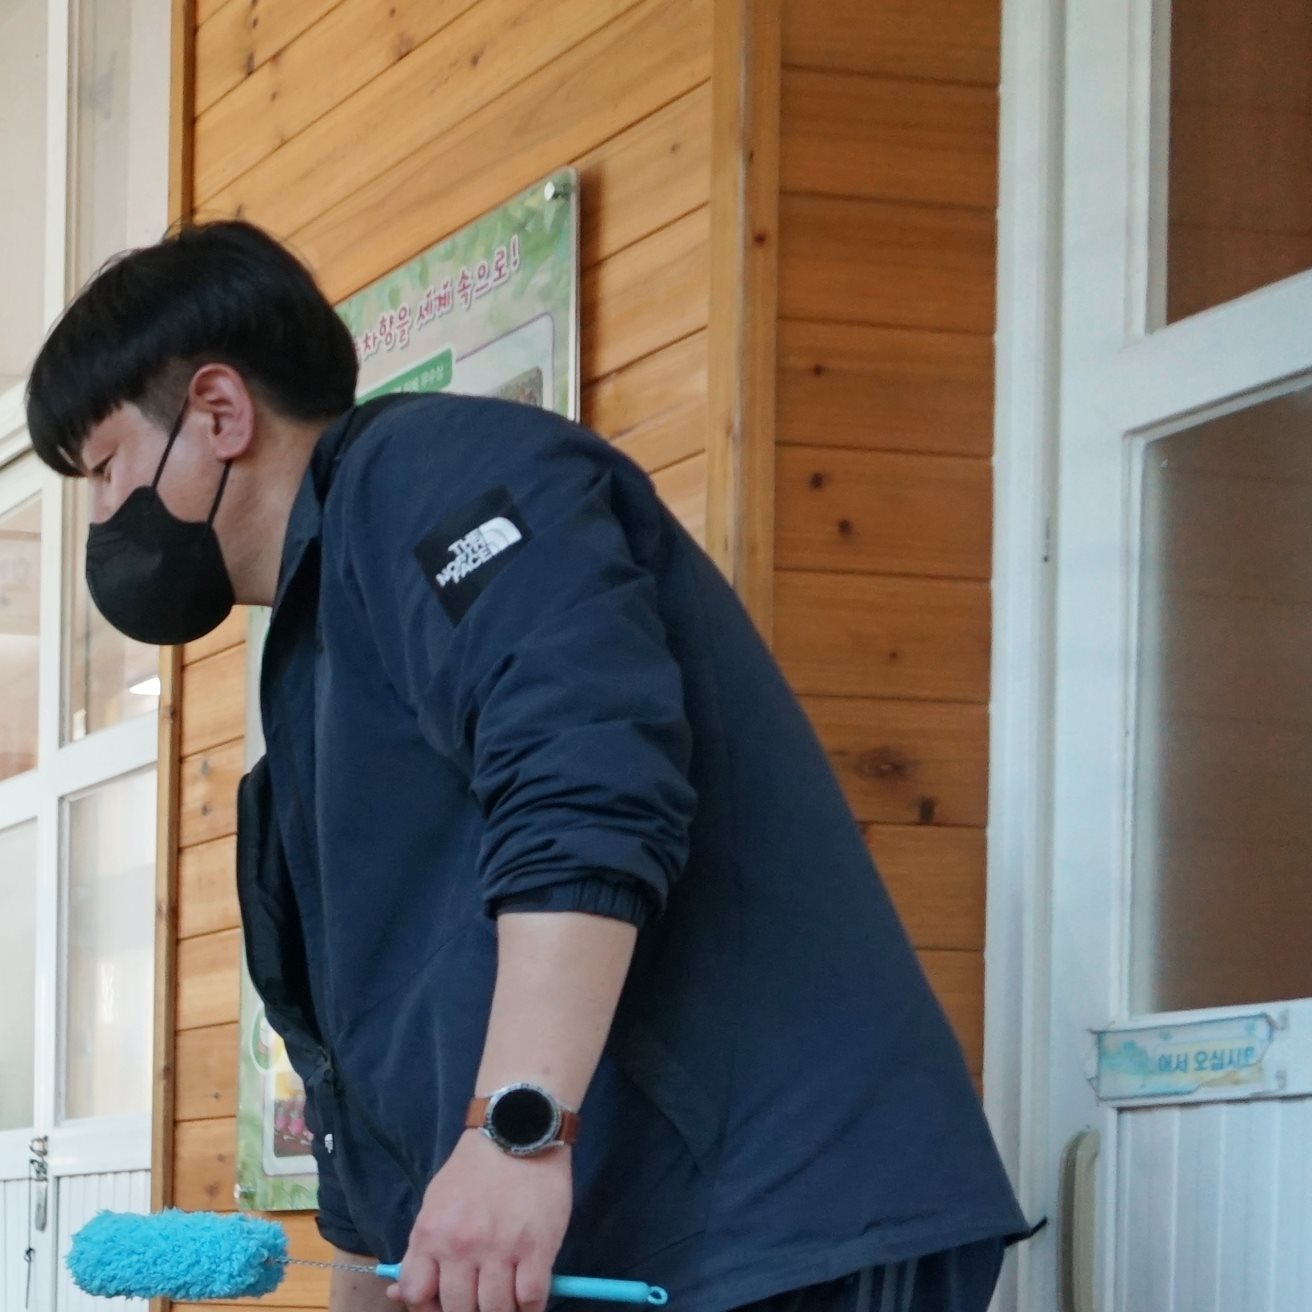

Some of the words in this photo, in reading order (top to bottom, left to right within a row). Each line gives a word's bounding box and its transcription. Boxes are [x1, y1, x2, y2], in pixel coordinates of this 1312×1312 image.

[354, 305, 411, 353] 차향을
[416, 281, 453, 324] 세계
[457, 236, 519, 306] 속으로!
[448, 529, 481, 557] THE
[453, 549, 493, 584] FACE
